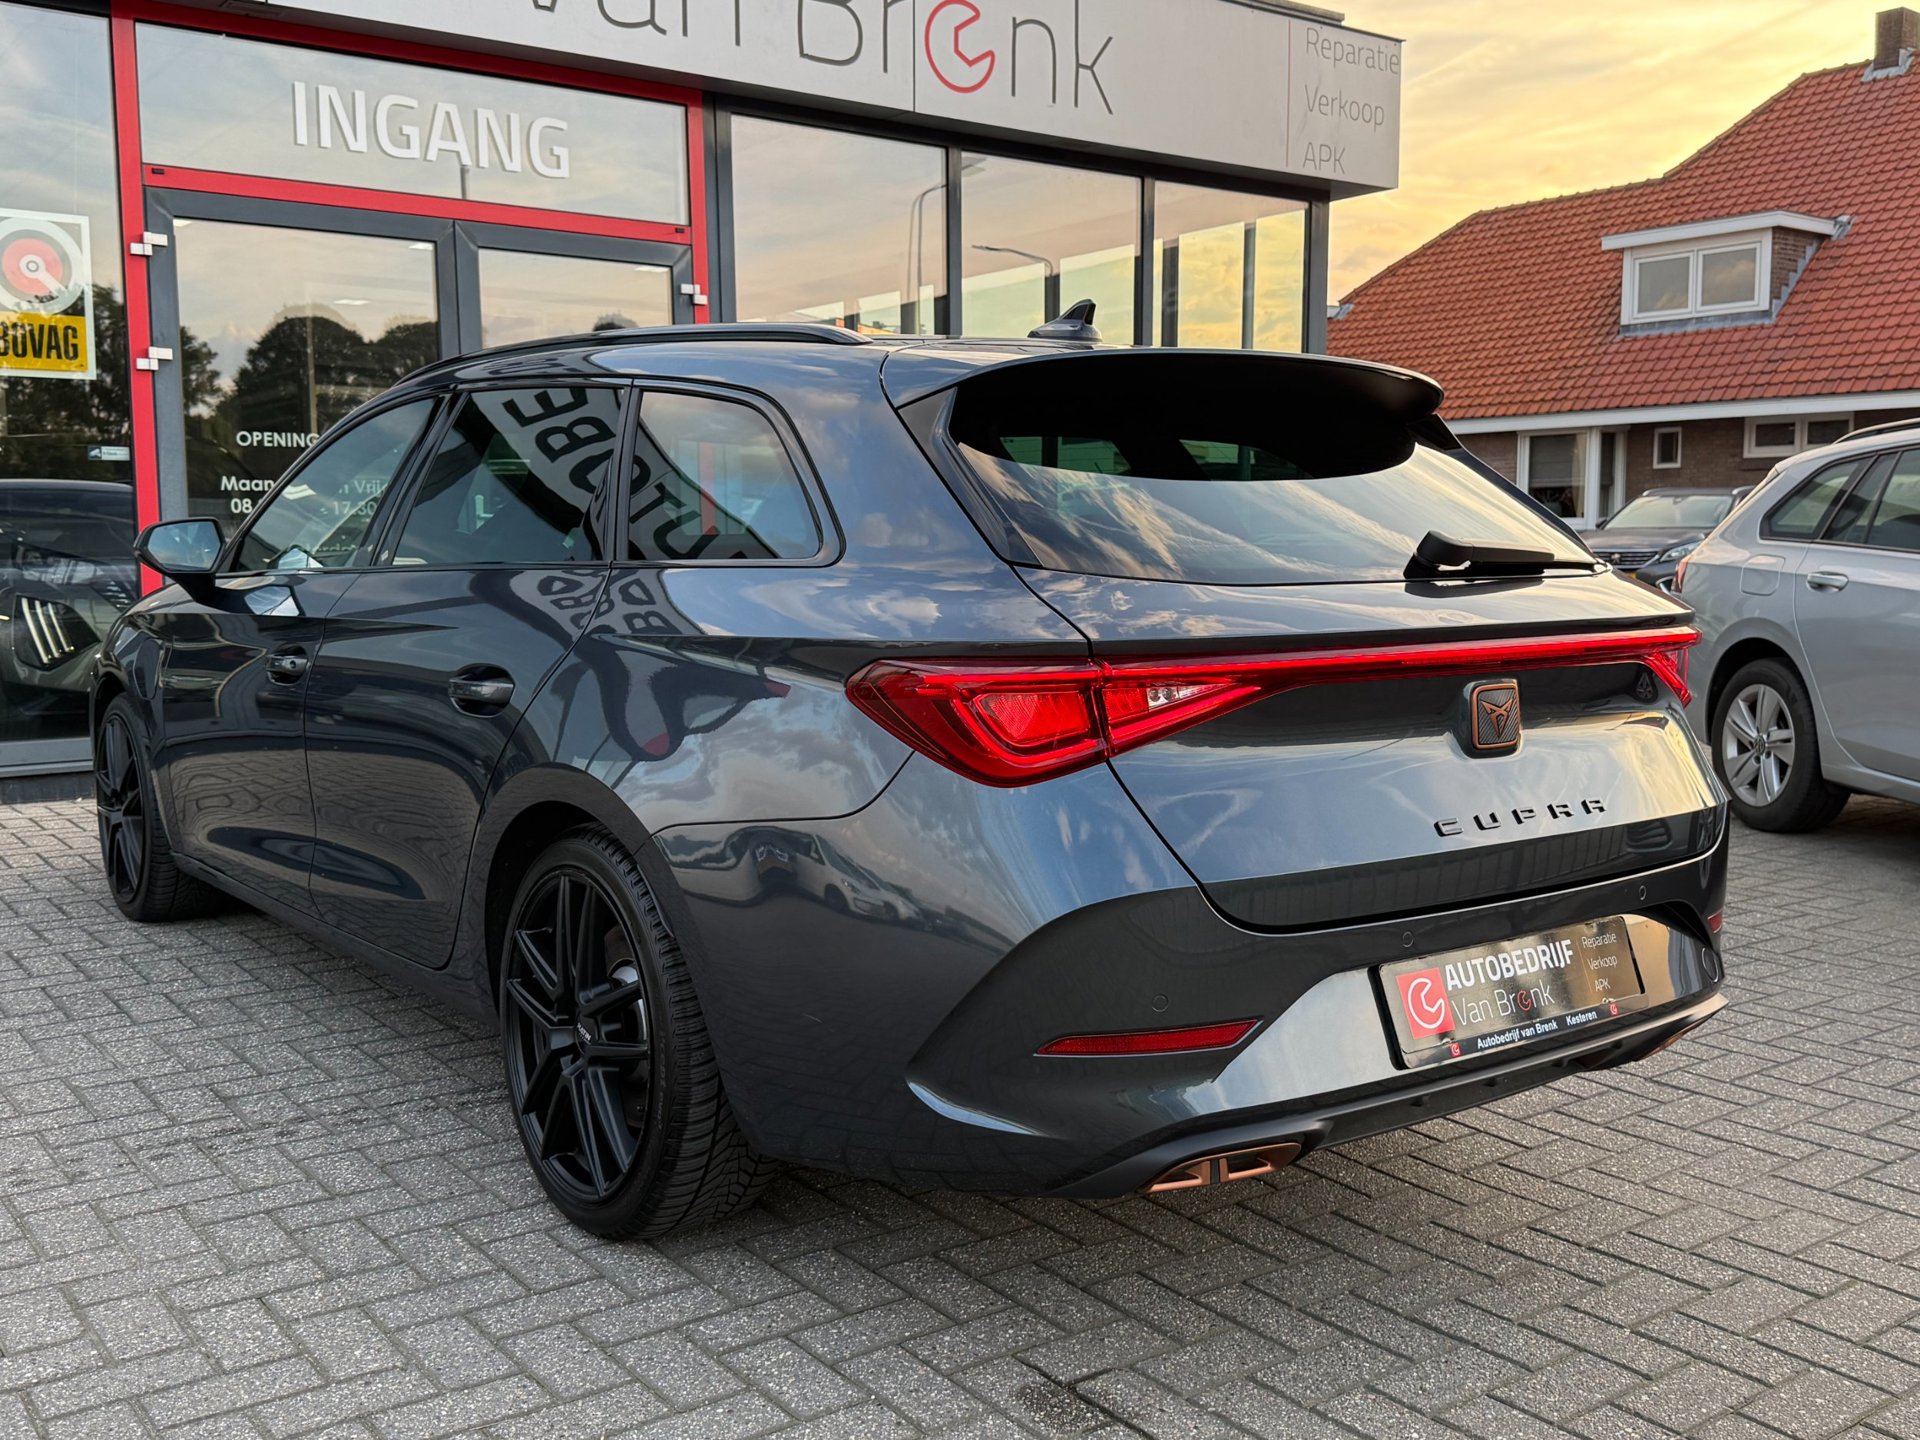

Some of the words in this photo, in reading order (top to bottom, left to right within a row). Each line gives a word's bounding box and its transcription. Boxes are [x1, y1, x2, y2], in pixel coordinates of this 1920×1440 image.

[1305, 27, 1400, 75] Reparatie
[1304, 84, 1385, 133] Verkoop
[292, 81, 570, 179] INGANG
[1302, 141, 1346, 175] APK
[0, 321, 79, 361] BOVAG
[354, 480, 385, 496] Vrij
[1434, 799, 1606, 837] CUPRA
[1581, 932, 1617, 949] Reparatie
[1445, 939, 1574, 991] AUTOBEDRIJF
[1587, 955, 1618, 970] Verkoop
[1594, 978, 1611, 992] APK
[1451, 998, 1494, 1026] Van
[1477, 1029, 1520, 1049] Autobedrijf
[1521, 1027, 1536, 1038] van
[1535, 1020, 1559, 1034] Brenk
[1566, 1010, 1598, 1026] Kesteren
